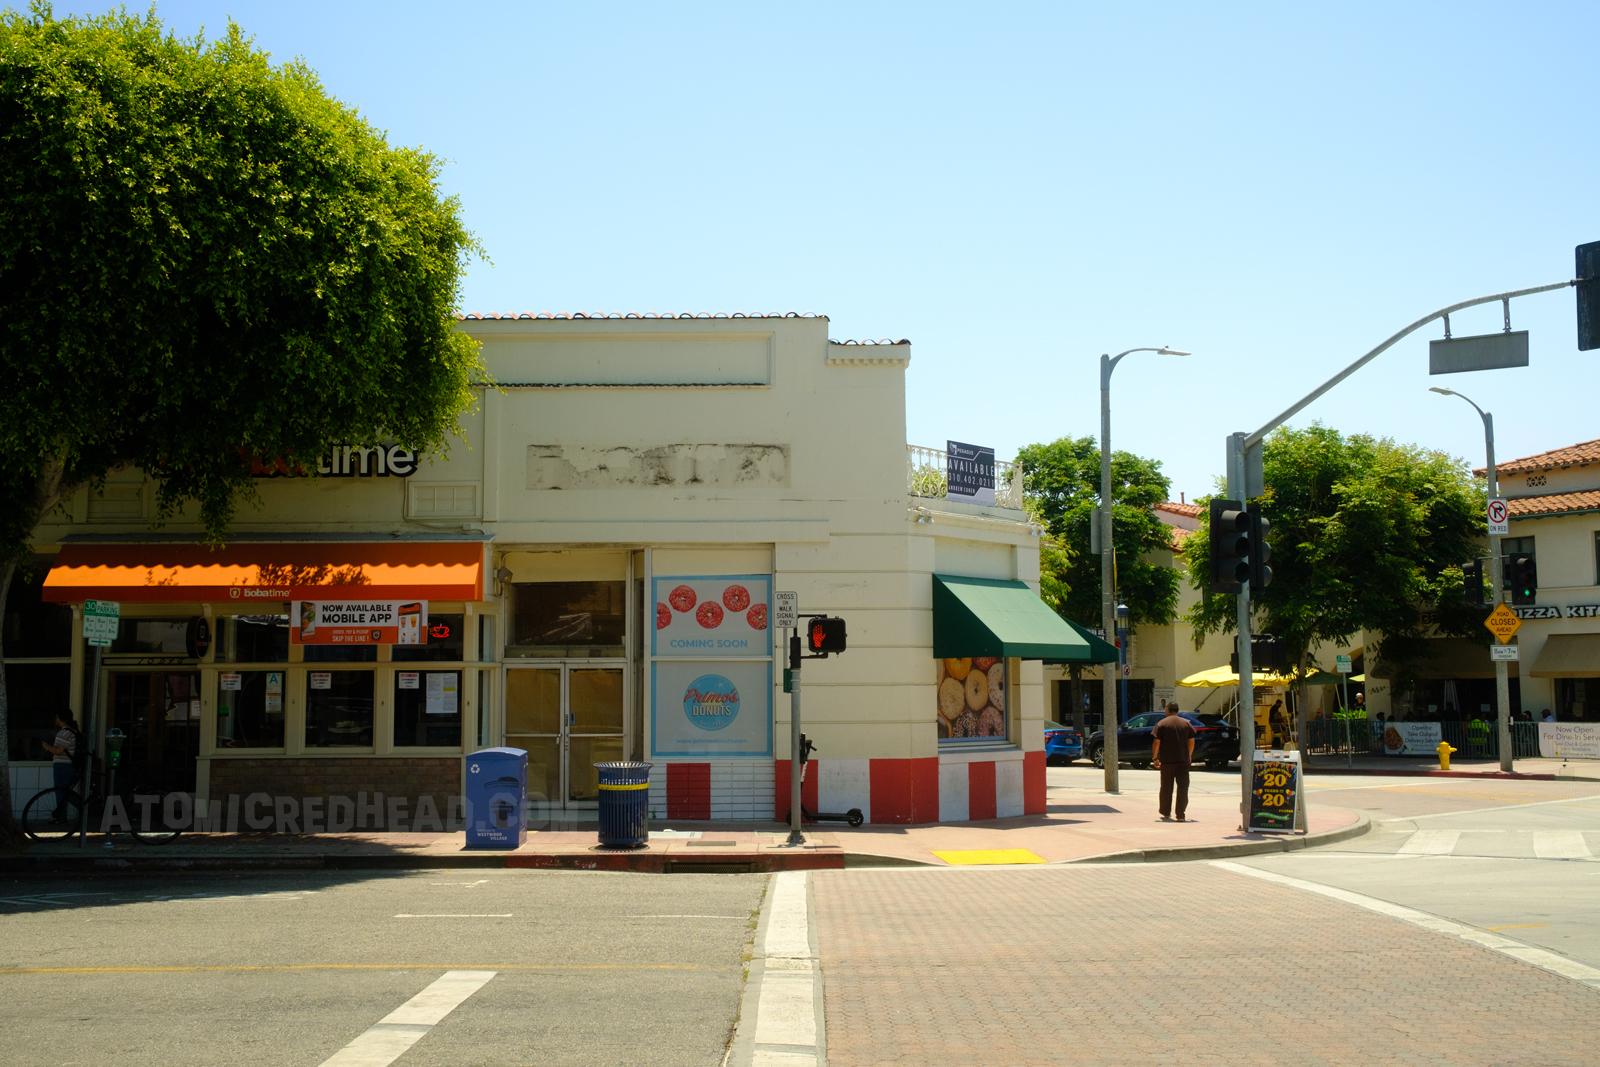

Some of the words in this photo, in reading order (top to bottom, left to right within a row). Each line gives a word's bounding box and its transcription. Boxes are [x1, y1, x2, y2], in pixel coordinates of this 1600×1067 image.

[948, 458, 994, 477] AVAILABLE
[948, 472, 994, 488] 310.402.0211
[244, 588, 290, 597] bobatime
[85, 601, 96, 610] 30
[97, 605, 118, 614] PARKING
[322, 604, 343, 612] NOW
[345, 604, 392, 612] AVAILABLE
[322, 613, 365, 623] MOBILE
[369, 613, 392, 623] APP
[1490, 618, 1516, 626] CLOSED
[669, 639, 714, 648] COMING
[716, 639, 748, 648] SOON
[269, 674, 278, 684] A
[683, 688, 739, 703] Primo's
[691, 705, 731, 716] DONUTS
[1573, 726, 1594, 734] Open
[1543, 732, 1554, 740] For
[1257, 767, 1292, 778] CELEBRATING
[1263, 773, 1287, 787] 20
[1262, 793, 1285, 807] 20
